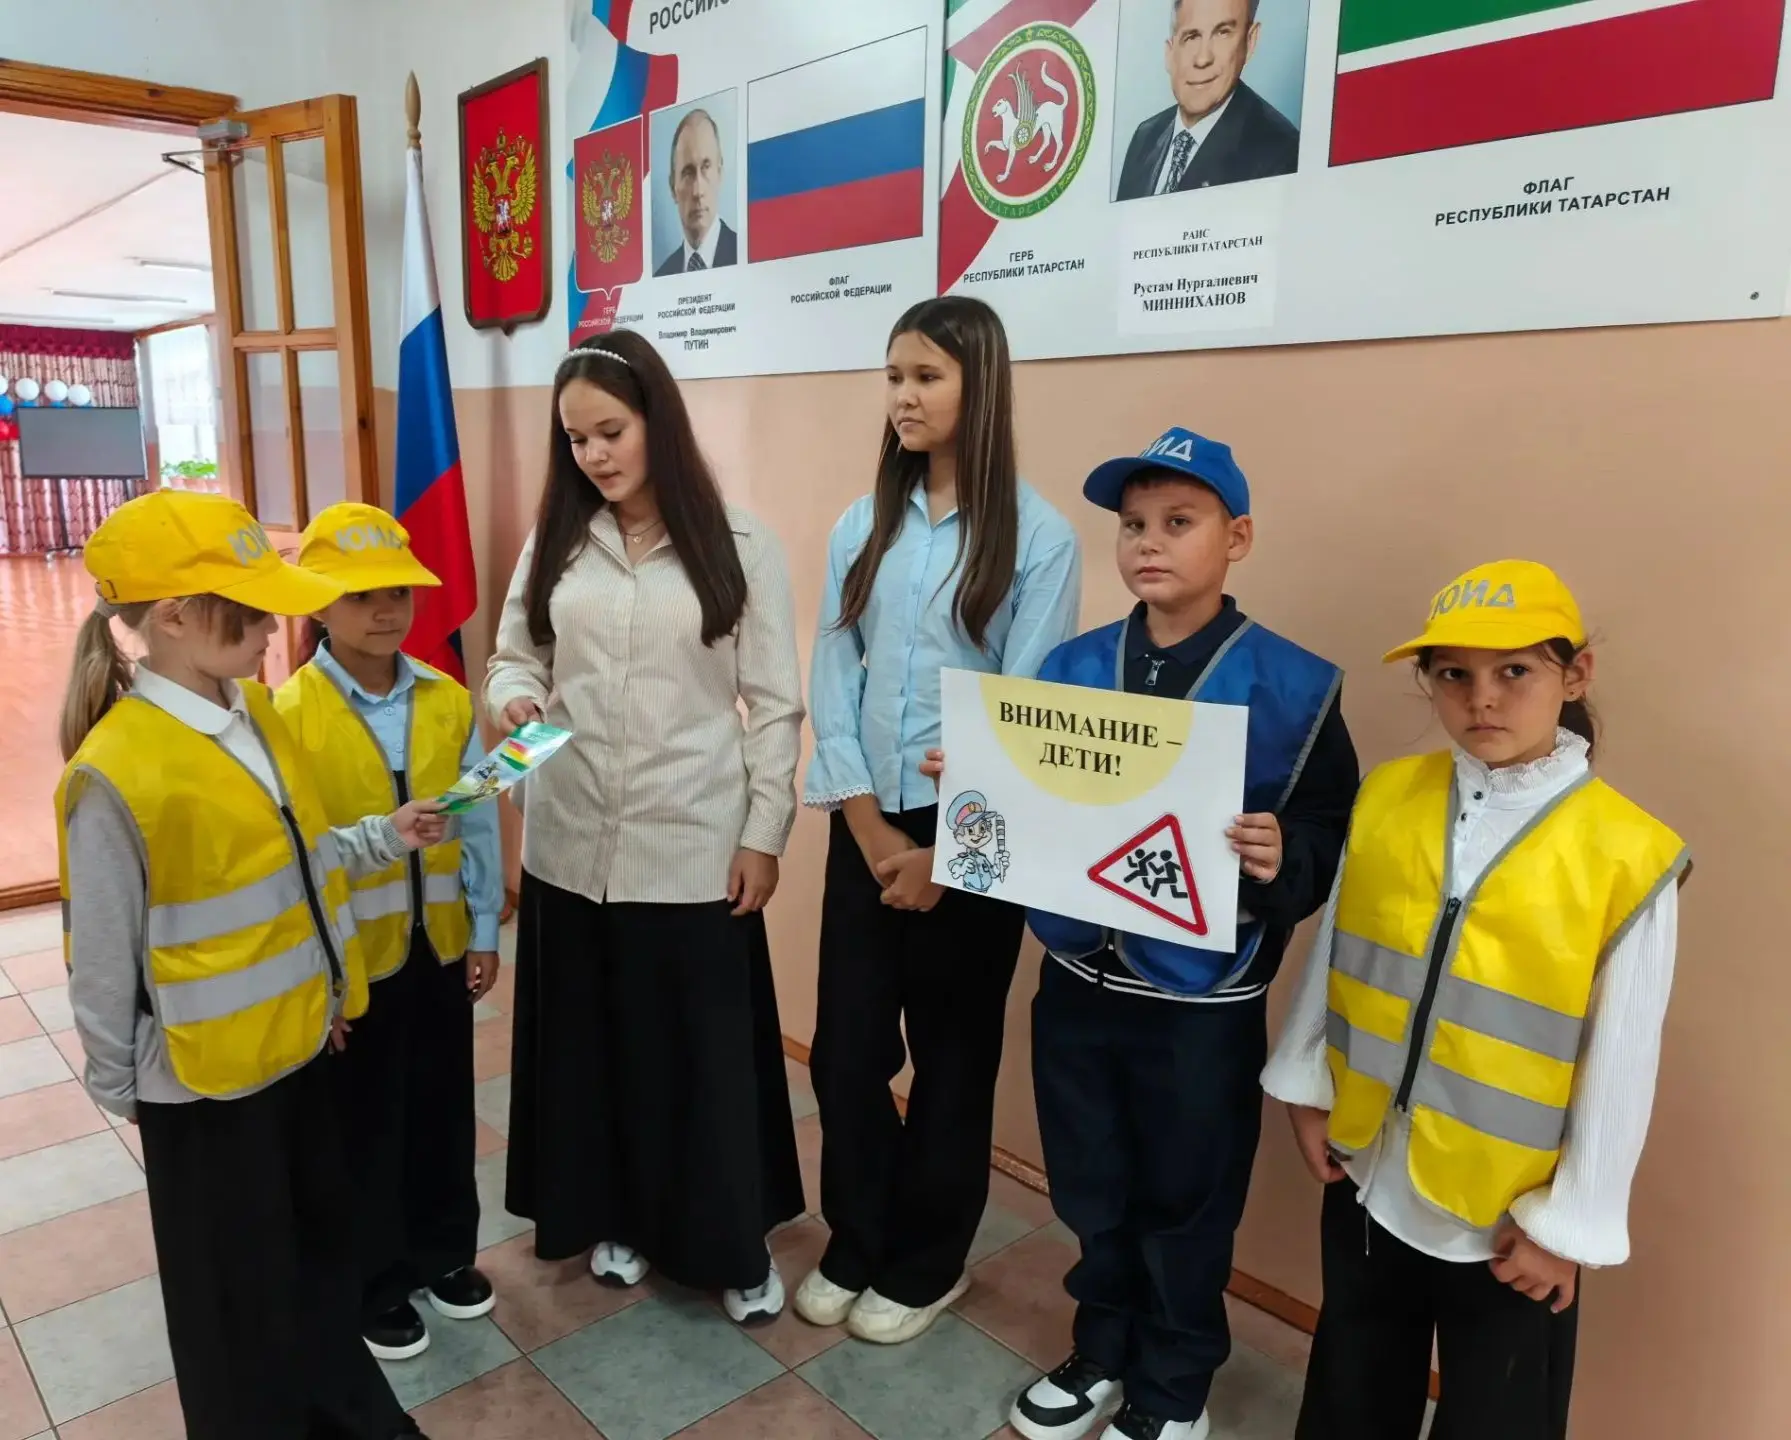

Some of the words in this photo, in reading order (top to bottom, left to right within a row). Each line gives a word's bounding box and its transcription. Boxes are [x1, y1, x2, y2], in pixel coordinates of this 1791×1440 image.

[649, 0, 729, 34] РОССИ
[1523, 177, 1574, 194] ФЛАГ
[1435, 200, 1552, 226] РЕСПУБЛИКИ
[1558, 187, 1671, 213] ТАТАРСТАН
[1182, 229, 1210, 241] РАИС
[1009, 250, 1034, 263] ГЕРБ
[1133, 243, 1198, 260] РЕСПУБЛИКИ
[1201, 235, 1263, 253] ТАТАРСТАН
[828, 275, 850, 286] ФЛАГ
[963, 267, 1025, 283] РЕСПУБЛИКИ
[1027, 259, 1085, 275] ТАТАРСТАН
[790, 289, 840, 303] РОССИЙСКОЙ
[843, 283, 892, 298] ФЕДЕРАЦИИ
[1134, 282, 1173, 297] Рустам
[1177, 274, 1258, 293] Нургалиевич
[678, 294, 712, 305] ПРЕЗИДЕНТ
[1143, 291, 1246, 312] МИННИХАНОВ
[658, 307, 696, 319] РОССИЙСКОЙ
[699, 303, 736, 314] ФЕДЕРАЦИИ
[684, 339, 709, 351] ПУТИН
[999, 701, 1159, 748] ВНИМАНИЕ
[1039, 742, 1121, 777] ДЕТИ!
